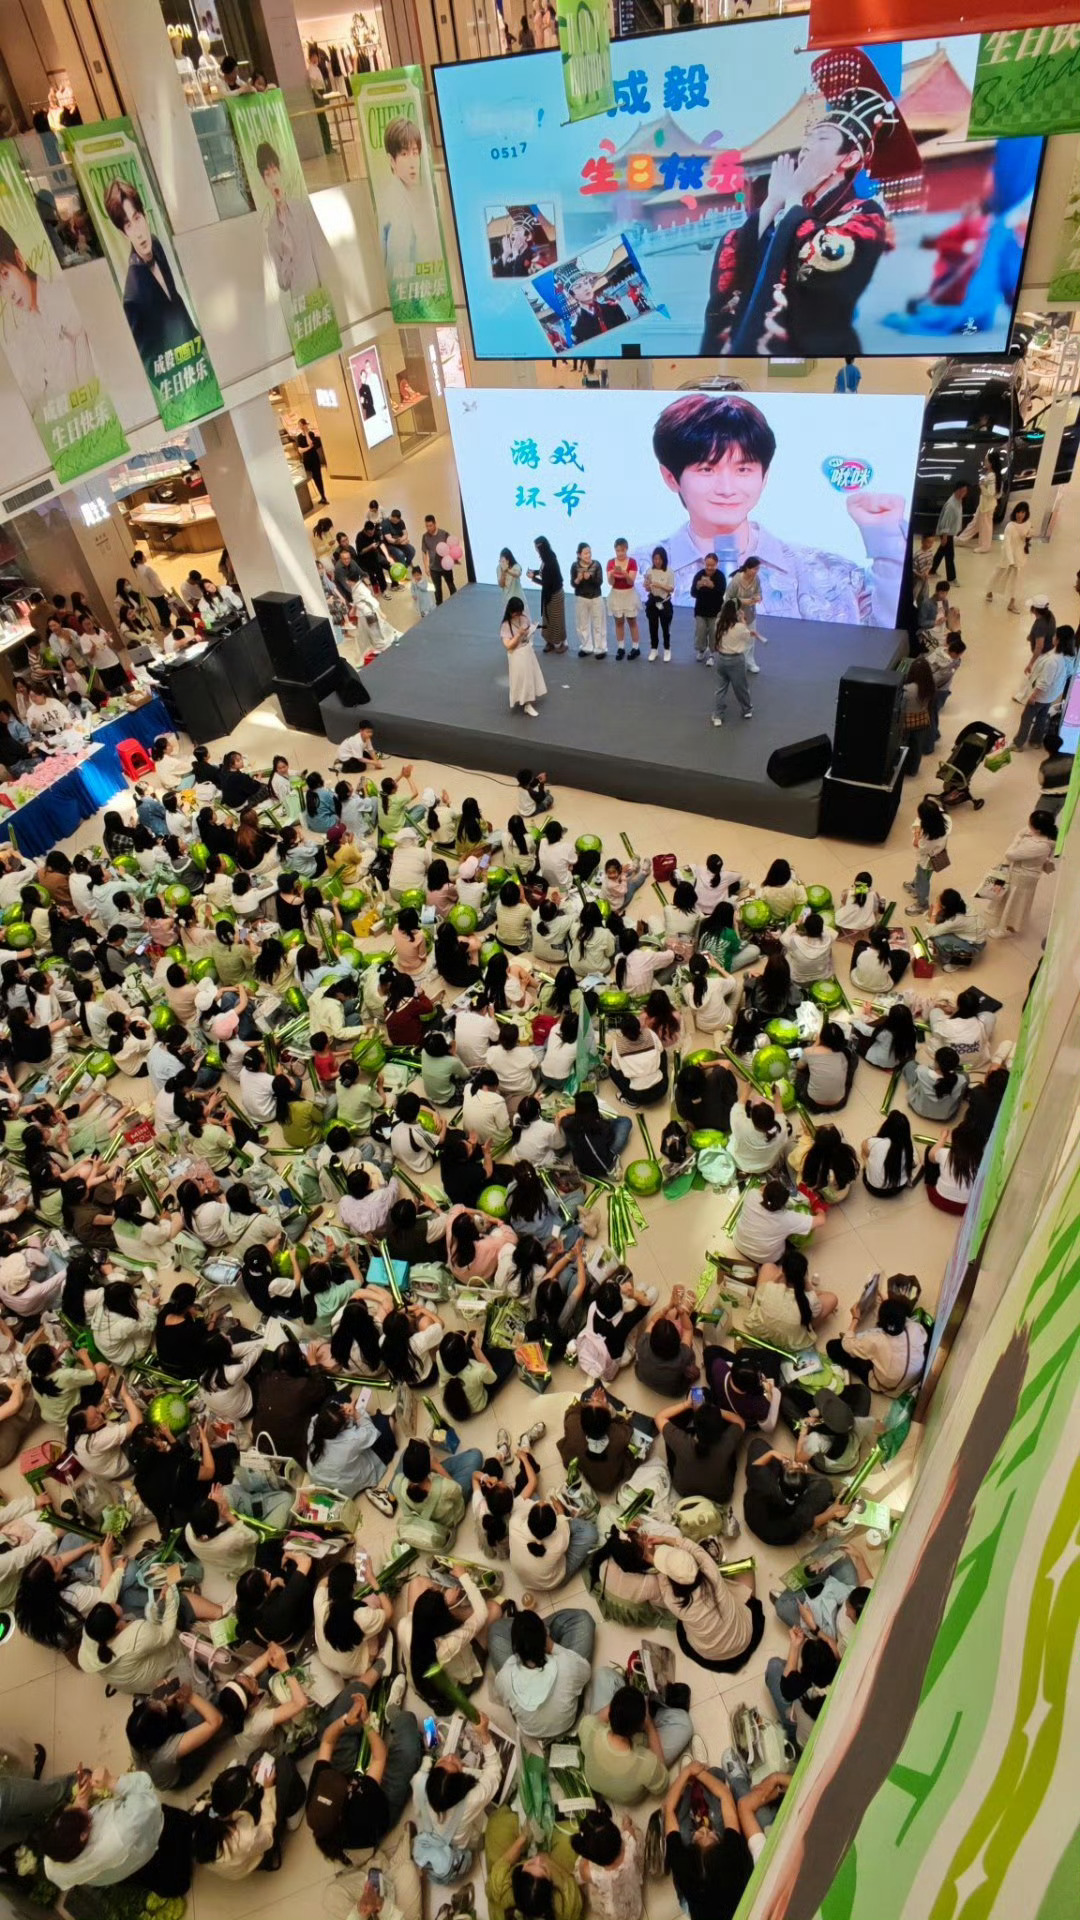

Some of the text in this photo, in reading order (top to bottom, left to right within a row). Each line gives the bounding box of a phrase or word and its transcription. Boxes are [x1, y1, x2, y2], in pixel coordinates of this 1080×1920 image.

[607, 64, 709, 117] 成毅
[490, 142, 527, 160] 0517
[580, 152, 744, 195] 生日快乐
[161, 357, 208, 400] 生日快乐
[52, 401, 111, 453] 生日快乐
[510, 437, 585, 472] 游戏
[514, 482, 586, 518] 环节
